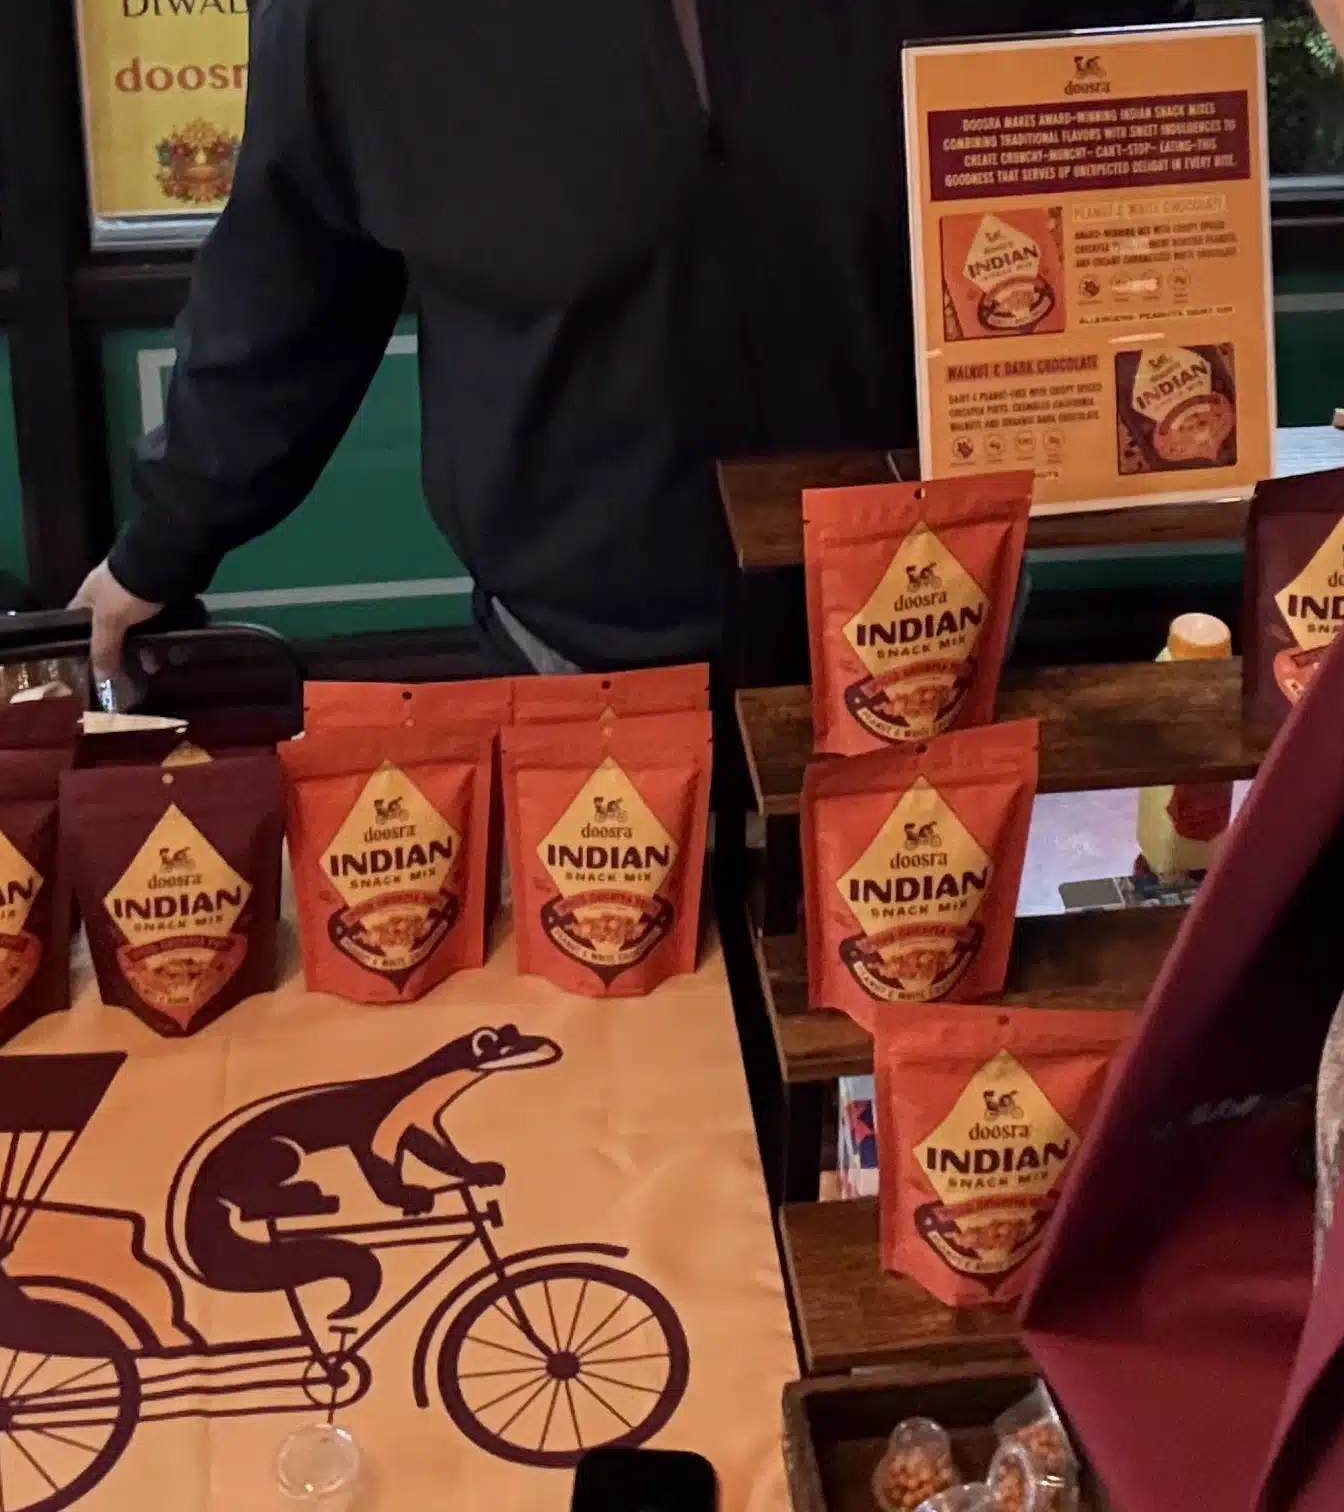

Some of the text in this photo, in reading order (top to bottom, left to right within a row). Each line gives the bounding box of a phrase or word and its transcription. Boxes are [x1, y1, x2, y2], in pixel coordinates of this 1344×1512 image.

[114, 56, 248, 93] doosr
[967, 244, 1039, 280] INDIAN
[1136, 360, 1210, 411] INDIAN
[894, 591, 947, 613] doosra
[856, 603, 983, 646] INDIAN
[1306, 624, 1343, 635] SNA
[876, 637, 966, 659] SNACK MIX
[363, 823, 417, 843] doosra
[580, 822, 633, 840] doosra
[329, 837, 454, 877] INDIAN
[547, 845, 670, 870] INDIAN
[890, 851, 948, 870] doosra
[147, 872, 203, 890] doosra
[349, 867, 437, 890] SNACK MIX
[564, 871, 652, 882] SNACK MIX
[849, 866, 989, 904] INDIAN
[113, 885, 243, 920] INDIAN
[871, 900, 968, 919] SNACK MIX
[133, 913, 224, 933] SNACK MIX
[968, 1123, 1030, 1142] doosra
[926, 1139, 1071, 1174] INDIAN
[947, 1171, 1049, 1189] SNACK MIX
